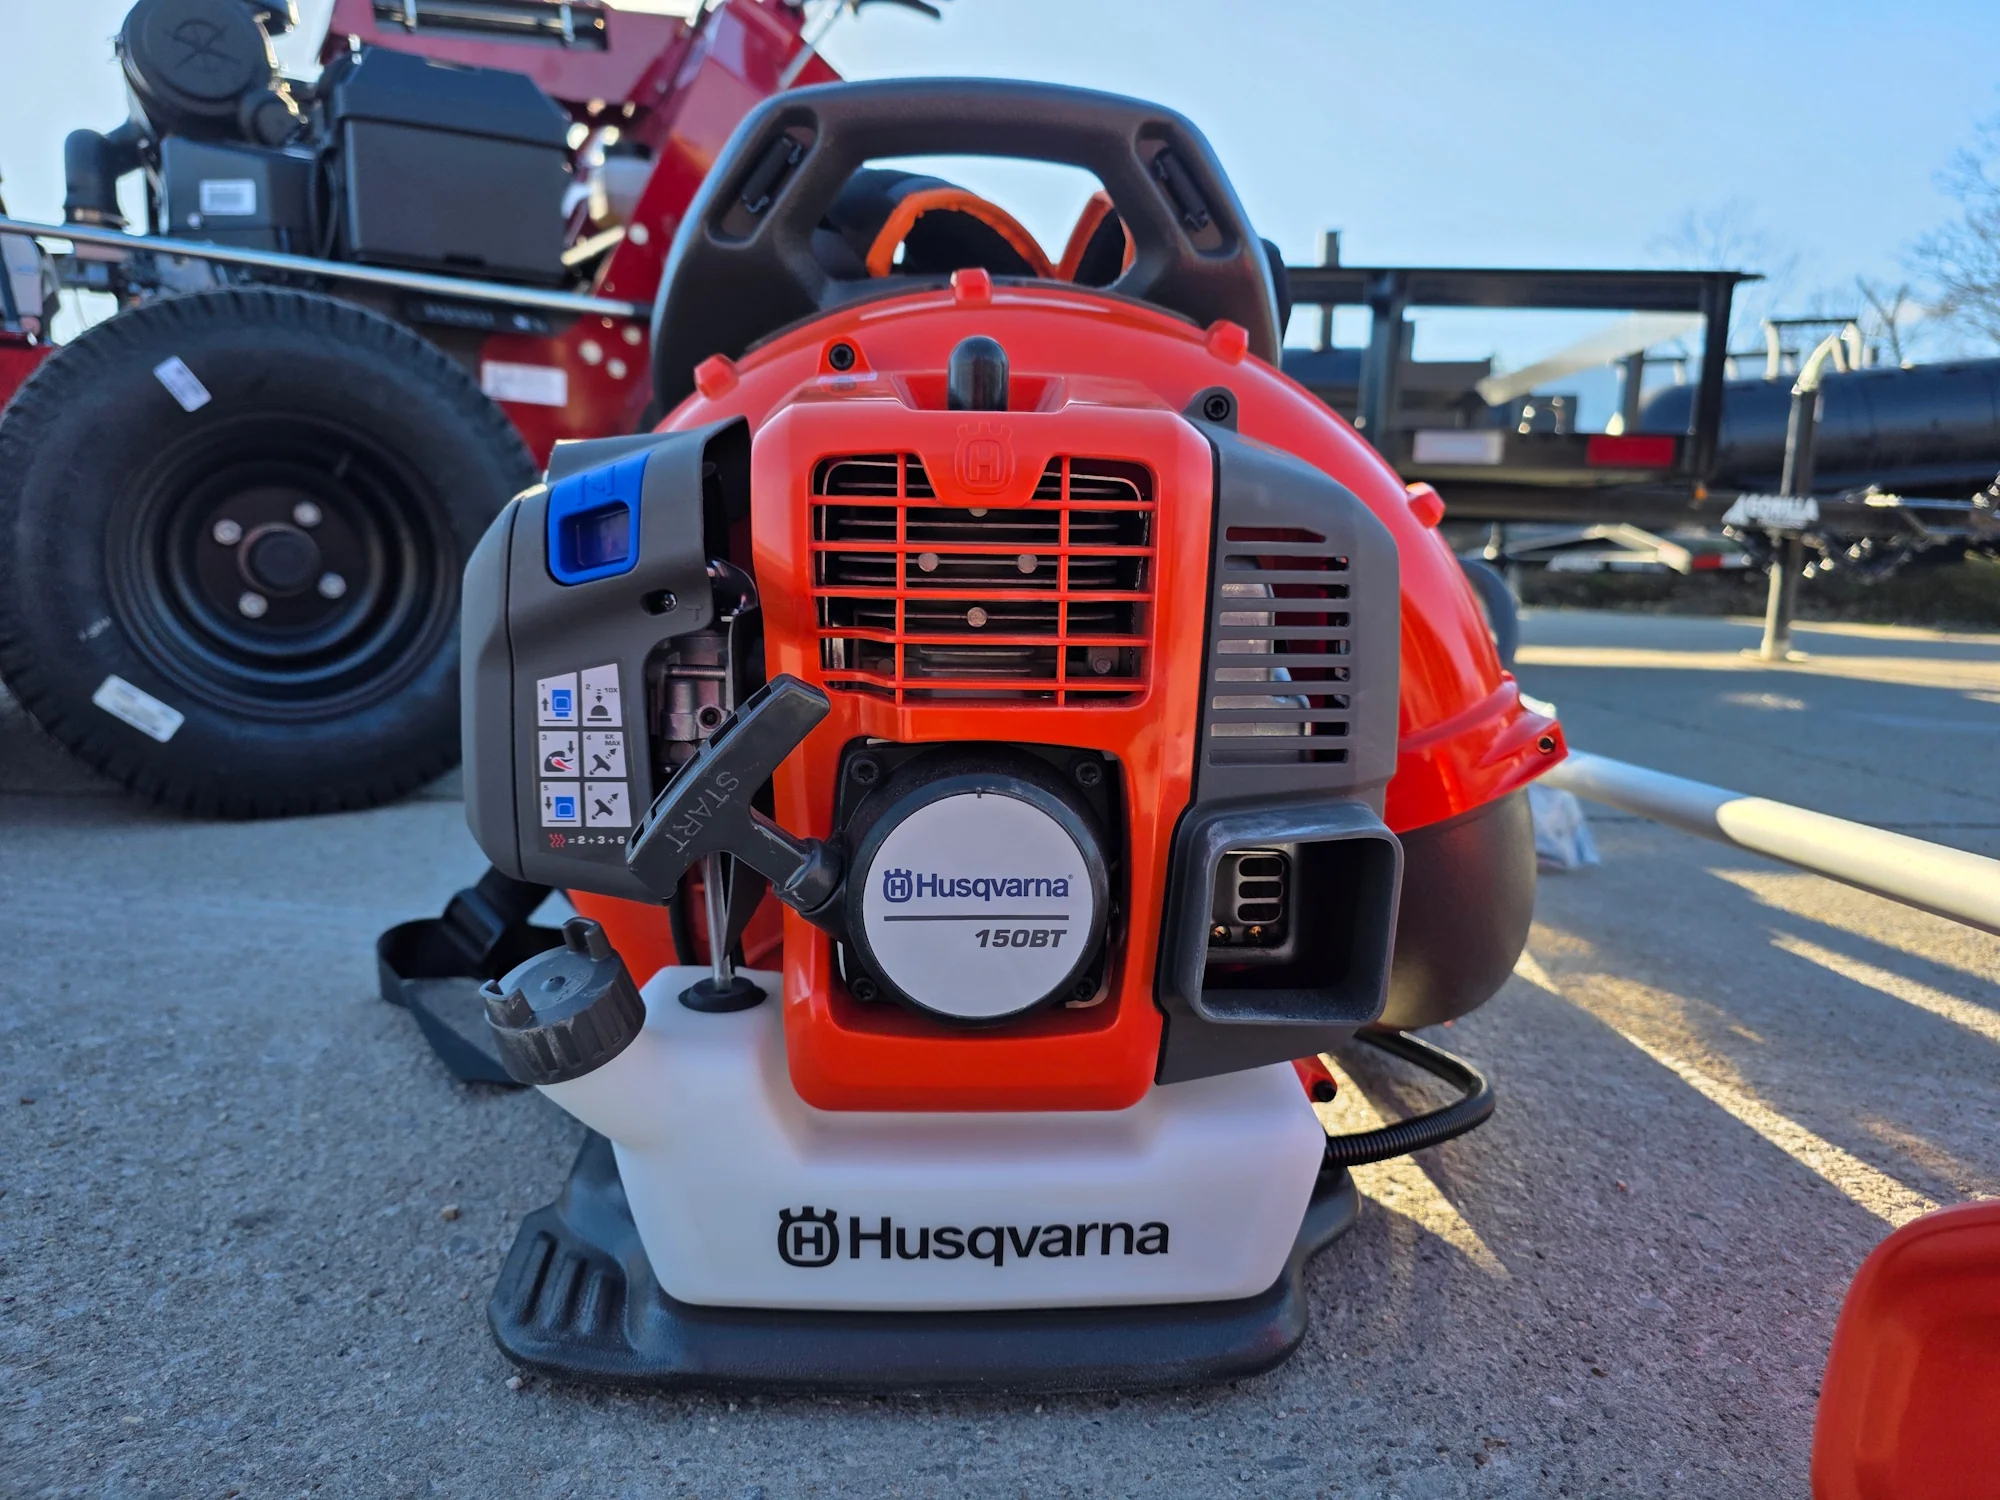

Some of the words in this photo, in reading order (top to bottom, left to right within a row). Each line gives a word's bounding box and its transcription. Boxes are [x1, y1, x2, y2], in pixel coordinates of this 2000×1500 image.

[665, 771, 740, 853] START
[974, 929, 1068, 948] 150BT
[849, 1215, 1170, 1267] Husqvarna
